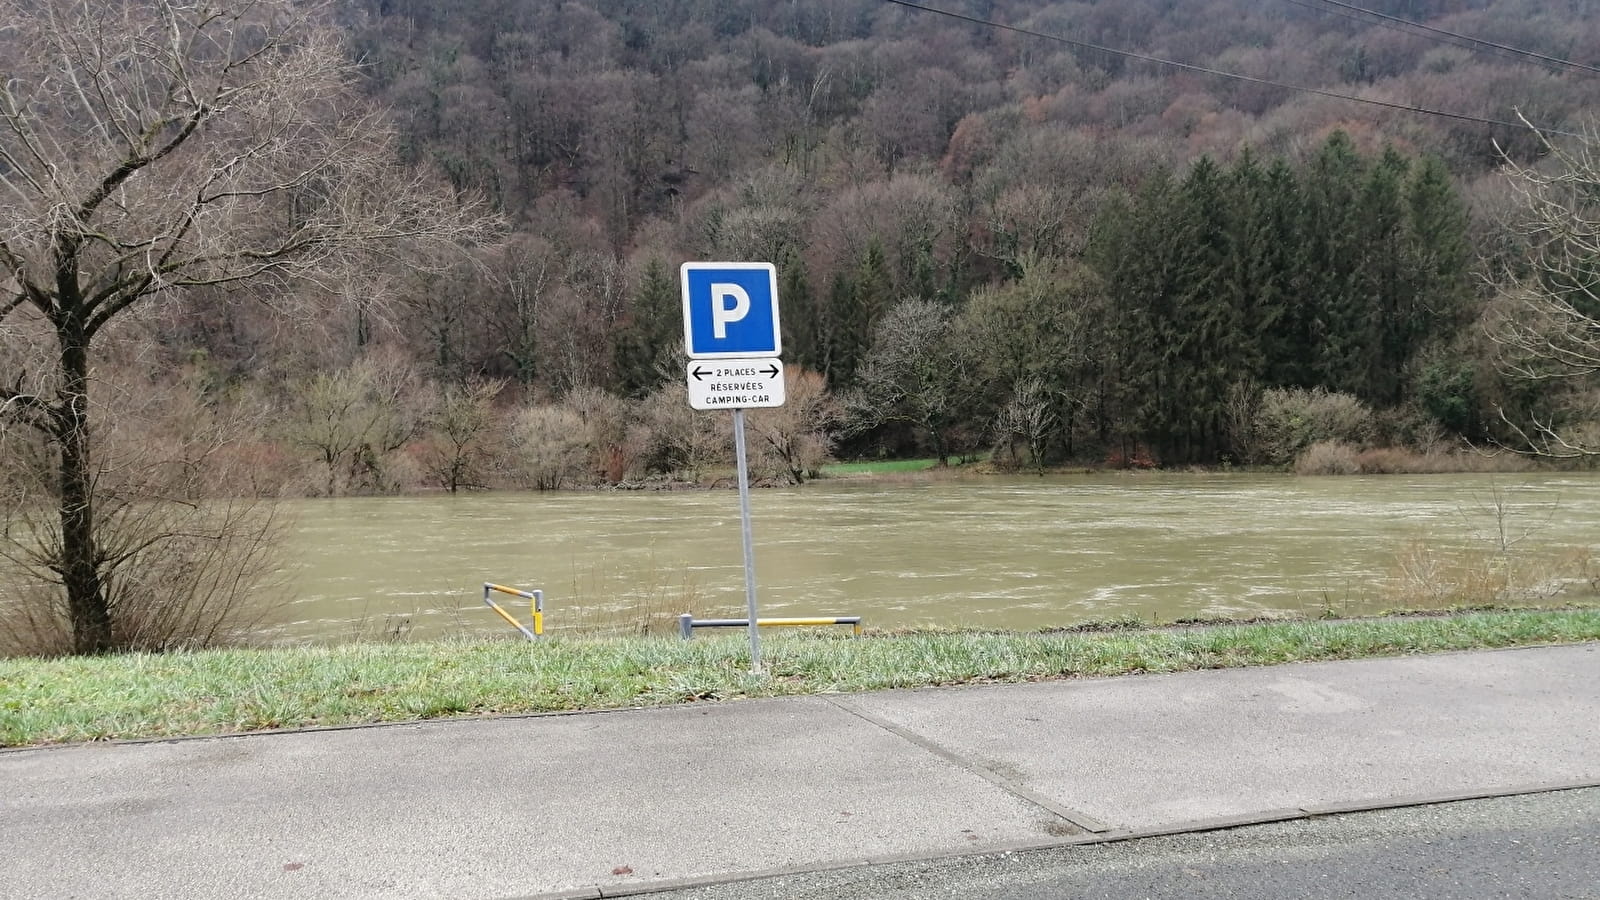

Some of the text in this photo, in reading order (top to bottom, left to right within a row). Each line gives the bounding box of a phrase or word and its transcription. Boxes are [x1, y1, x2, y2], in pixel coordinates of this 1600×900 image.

[711, 283, 750, 338] P
[716, 368, 756, 377] 2 PLACES
[710, 381, 763, 392] RÉSERVÉES
[706, 395, 770, 404] CAMPING-CAR
